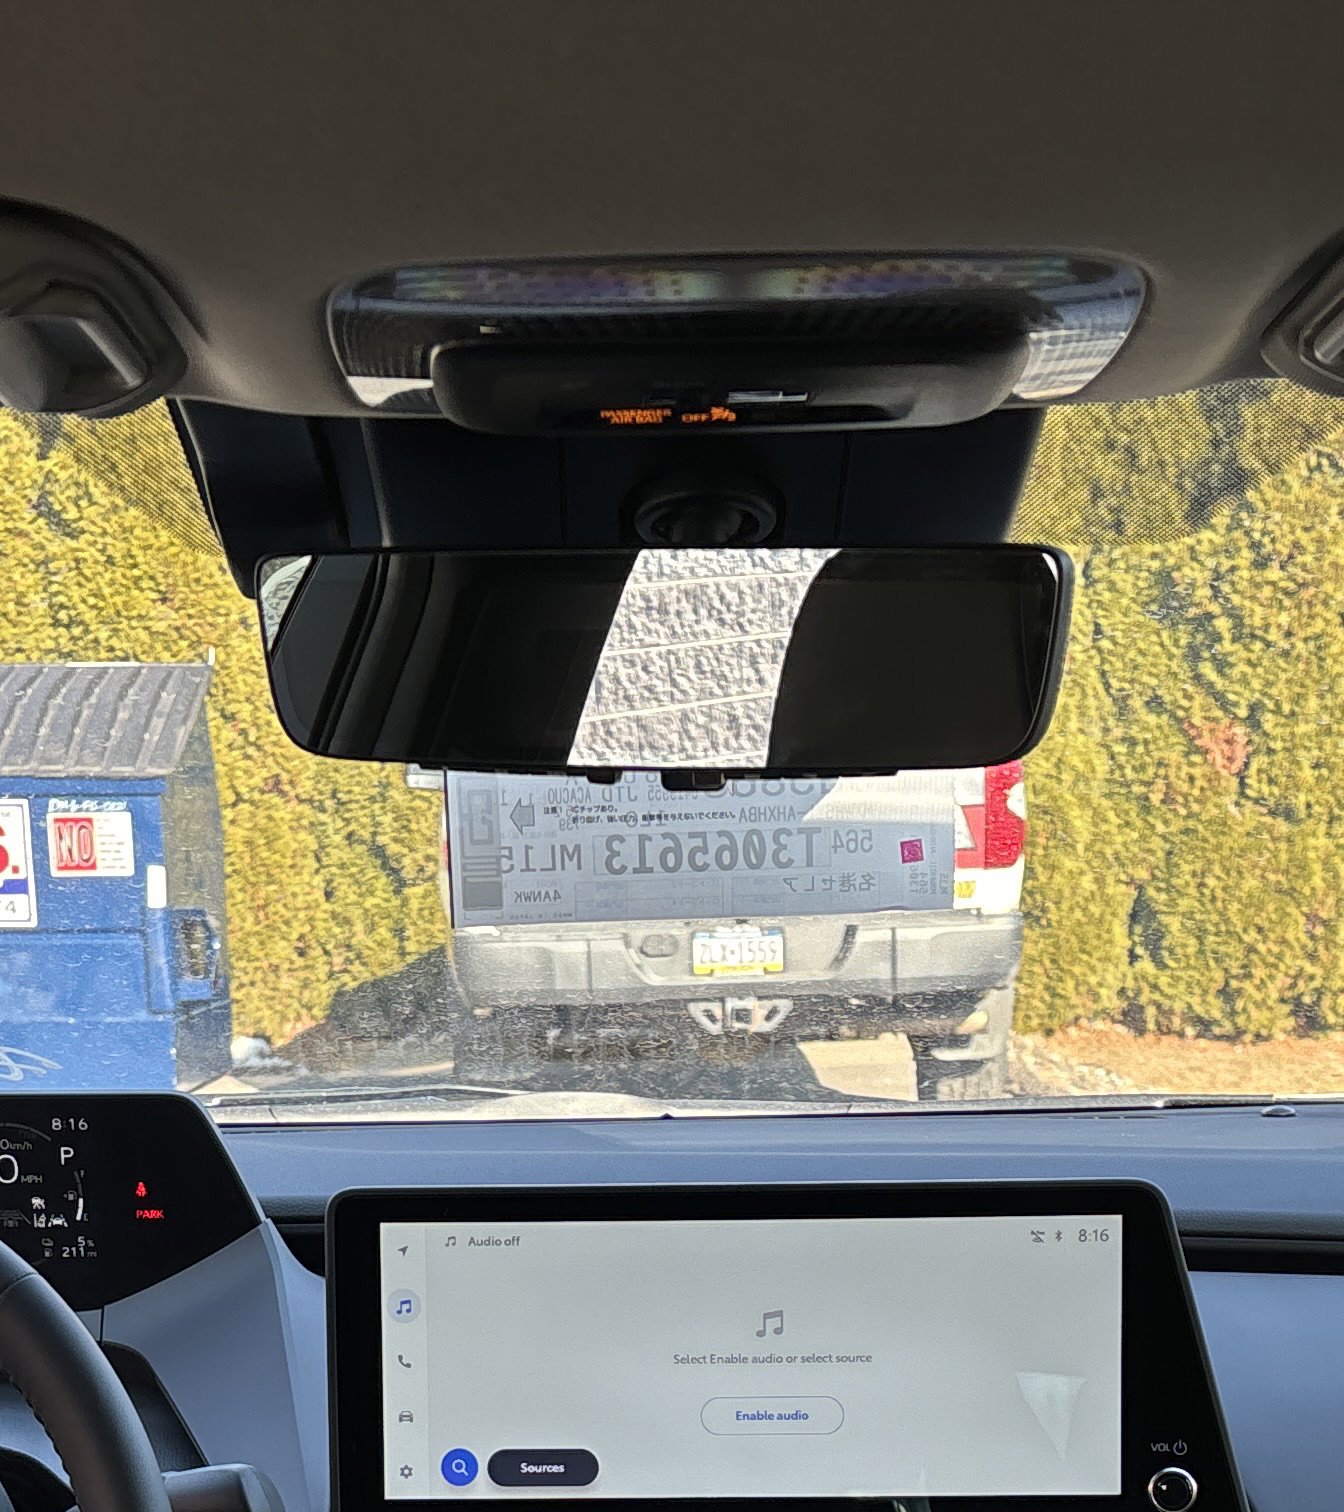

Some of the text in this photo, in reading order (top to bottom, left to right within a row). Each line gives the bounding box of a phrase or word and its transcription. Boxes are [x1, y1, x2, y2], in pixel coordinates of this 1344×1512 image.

[682, 413, 708, 422] OFF
[55, 821, 97, 867] NO
[51, 1117, 89, 1131] 8:16
[60, 1146, 75, 1166] P
[21, 1174, 44, 1184] MPH
[135, 1208, 164, 1219] PARK
[77, 1235, 86, 1247] 5
[467, 1236, 521, 1247] Audio off
[1077, 1228, 1110, 1243] 8:16
[62, 1246, 85, 1258] 211
[673, 1352, 873, 1365] Select Enable audio or select source
[735, 1410, 810, 1422] Enable audio
[1150, 1442, 1170, 1453] VOL
[520, 1462, 565, 1473] Sources
